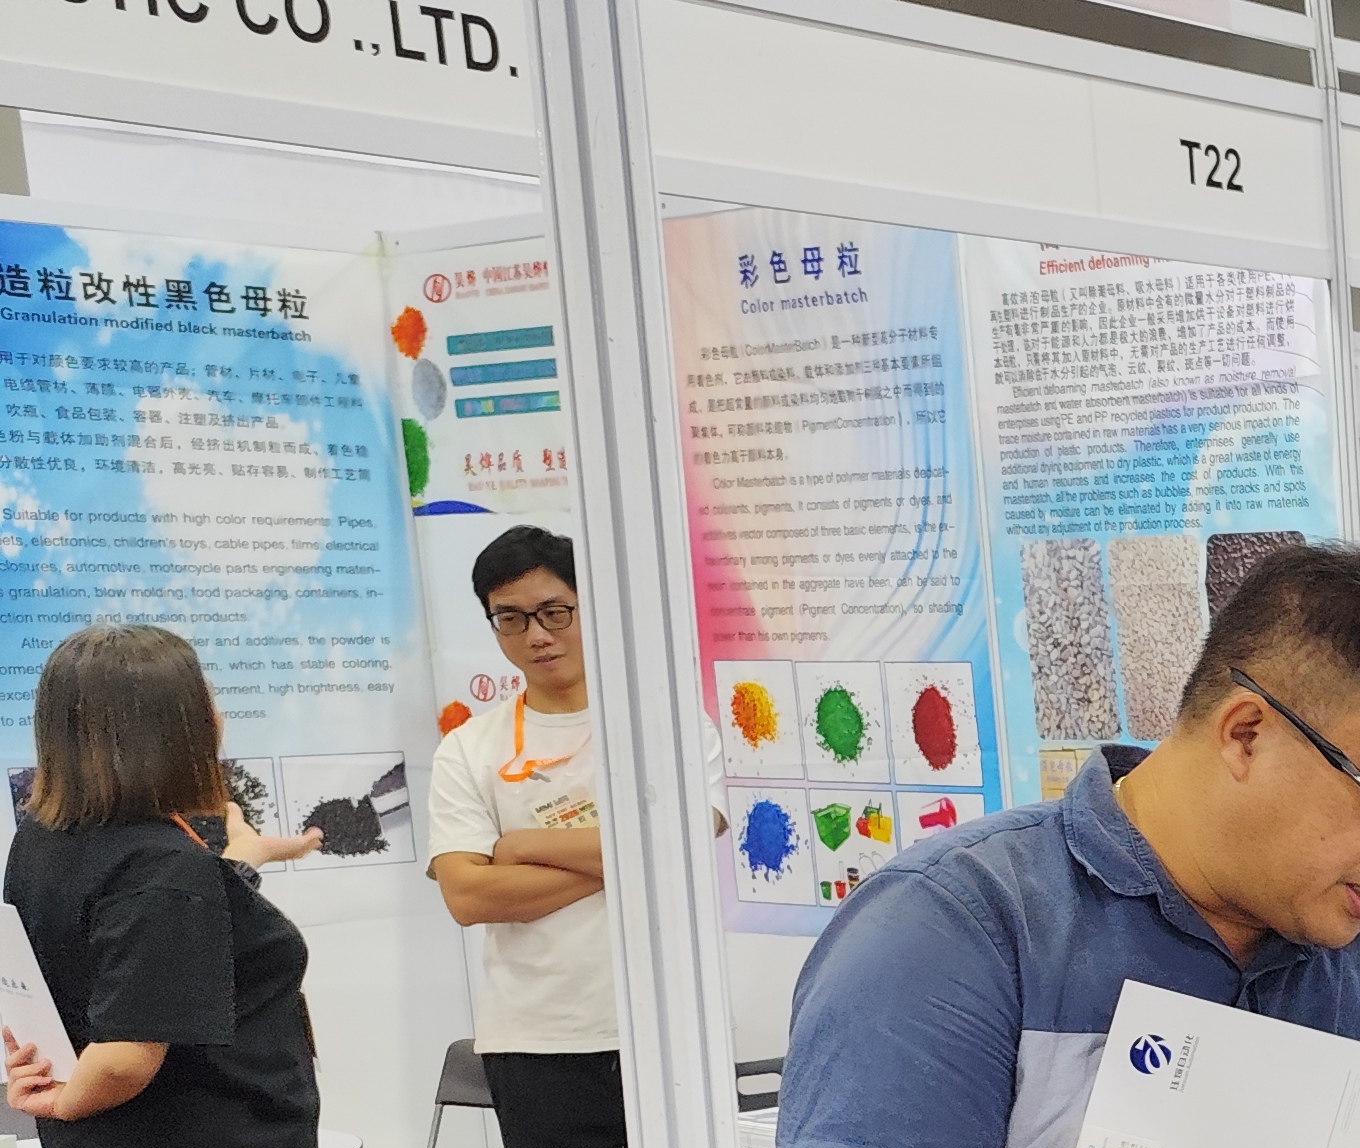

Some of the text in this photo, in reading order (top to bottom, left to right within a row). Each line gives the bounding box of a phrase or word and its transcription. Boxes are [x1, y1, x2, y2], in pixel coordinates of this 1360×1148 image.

[1179, 138, 1244, 193] T22
[738, 241, 862, 289] 彩色母粒
[1039, 259, 1086, 275] Efficient
[740, 286, 869, 315] Color masterbatch
[1, 307, 312, 343] Granulation modified black masterbatch
[3, 508, 247, 528] Suitable for products with high color
[1246, 497, 1309, 511] raw materials
